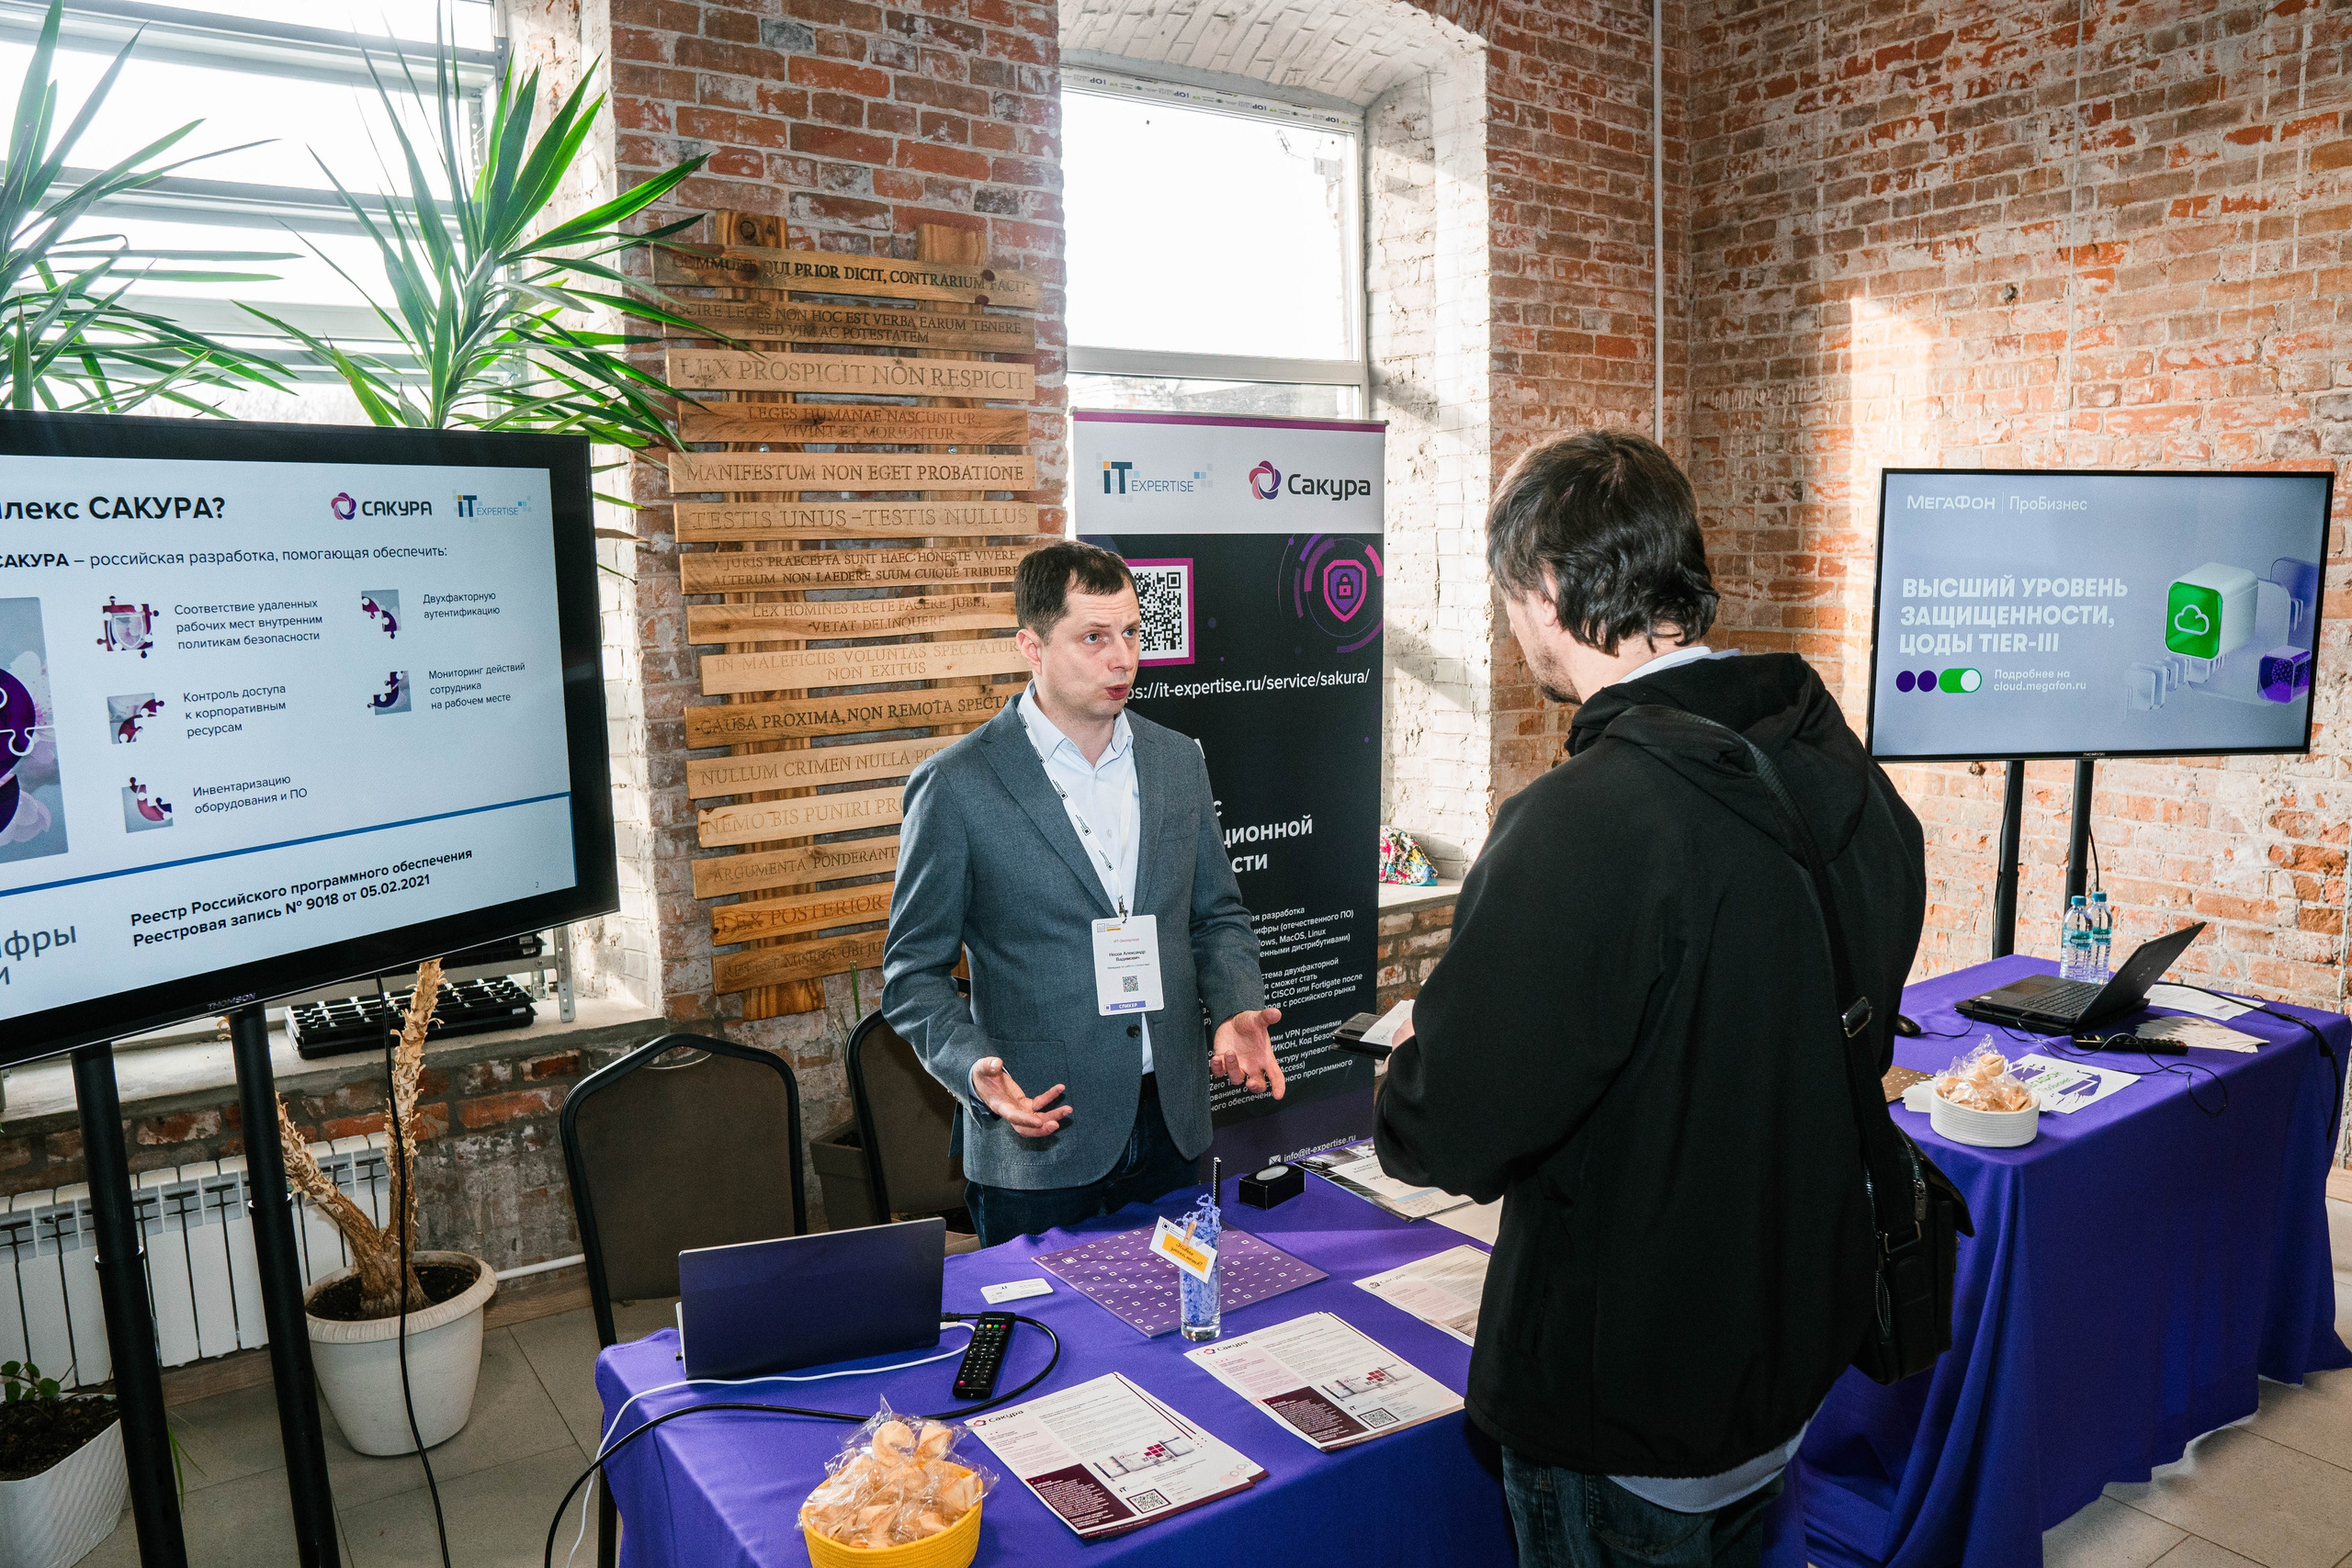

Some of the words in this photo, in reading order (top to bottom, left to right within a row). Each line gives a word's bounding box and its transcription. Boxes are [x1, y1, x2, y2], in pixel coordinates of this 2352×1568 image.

[794, 263, 841, 279] PRIOR
[843, 266, 888, 284] DICIT,
[889, 270, 985, 289] CONTRARIUM
[726, 305, 772, 319] LEGES
[775, 308, 807, 321] NON
[812, 310, 842, 322] HOC
[846, 311, 870, 325] EST
[874, 313, 916, 328] VERBA
[920, 316, 966, 331] EARUM
[972, 320, 1023, 334] TENERE
[757, 323, 784, 335] SED
[820, 326, 839, 339] AC
[843, 327, 930, 344] POTESTATEM
[680, 357, 731, 379] LEX
[738, 360, 865, 384] PROSPICIT
[873, 366, 924, 386] NON
[931, 367, 1027, 389] RESPICIT
[747, 406, 797, 421] LEGES
[804, 408, 882, 423] HUMANAE
[887, 410, 981, 426] NASCUNTUR,
[839, 425, 859, 438] ET
[863, 426, 956, 440] MORIUNTUR
[687, 464, 816, 481] MANIFESTUM
[822, 465, 863, 480] NON
[867, 465, 912, 480] EGET
[916, 465, 1024, 480] PROBATIONE
[1131, 479, 1194, 492] EXPERTISE
[1287, 474, 1372, 502] Сакура
[89, 496, 226, 519] САКУРА?
[362, 501, 433, 516] САКУРА
[477, 506, 518, 516] EXPERTISE
[2009, 495, 2087, 514] ПроБизнес
[692, 511, 773, 530] TESTIS
[780, 510, 847, 528] UNUS
[944, 508, 1028, 525] NULLUS
[90, 551, 185, 569] российская
[189, 548, 278, 566] разработка,
[282, 548, 369, 561] помогающая
[373, 546, 447, 558] обеспечить:
[724, 557, 763, 570] JURIS
[768, 554, 841, 568] PRAECEPTA
[844, 553, 877, 565] SUNT
[919, 551, 971, 563] HONESTE
[976, 550, 1020, 561] VIVERE,
[712, 573, 775, 586] ALTERUM
[783, 572, 811, 584] NON
[876, 570, 910, 581] SUUM
[914, 568, 960, 581] CUIQUE
[1902, 574, 2016, 598] ВЫСШИЙ
[2021, 577, 2129, 598] УРОВЕНЬ
[175, 603, 255, 615] Соответствие
[258, 600, 318, 613] удаленных
[423, 592, 496, 605] Двухфакторную
[752, 605, 780, 618] LEX
[784, 604, 848, 616] HOMINES
[852, 602, 897, 614] RECTE
[899, 599, 946, 611] FACERE
[951, 596, 990, 611] JUBET,
[424, 607, 501, 620] аутентификацию
[1900, 604, 2115, 628] ЗАЩИЩЕННОСТИ,
[176, 621, 226, 635] рабочих
[229, 620, 255, 629] мест
[258, 615, 323, 629] внутренним
[811, 620, 856, 633] VETAT
[862, 615, 945, 631] DELINQUERE
[178, 637, 241, 649] политикам
[243, 632, 320, 645] безопасности
[1899, 633, 1973, 656] ЦОДЫ
[1978, 632, 2060, 653] TIER-III
[715, 659, 734, 671] IN
[844, 646, 926, 663] VOLUNTAS
[428, 667, 484, 680] Мониторинг
[485, 662, 526, 675] действий
[828, 666, 863, 681] NON
[870, 662, 926, 678] EXITUS
[1994, 669, 2054, 681] Подробнее
[2057, 670, 2070, 679] на
[184, 690, 240, 703] Контроль
[243, 685, 286, 698] доступа
[430, 682, 481, 695] сотрудника
[1993, 681, 2086, 693] cloud.megafon.ru
[186, 712, 192, 720] к
[196, 702, 287, 719] корпоративным
[431, 701, 442, 709] на
[445, 697, 483, 710] рабочем
[486, 694, 511, 703] месте
[700, 716, 758, 734] CAUSA
[762, 709, 846, 729] PROXIMA,
[847, 705, 883, 722] NON
[888, 699, 954, 718] REMOTA
[187, 723, 243, 739] ресурсам
[700, 763, 778, 786] NULLUM
[784, 756, 852, 776] CRIMEN
[855, 750, 910, 770] NULLA
[193, 775, 291, 797] Инвентаризацию
[195, 794, 278, 814] оборудования
[280, 793, 288, 801] и
[290, 788, 308, 799] ПО
[705, 813, 765, 835] NEMO
[772, 809, 799, 827] BIS
[804, 800, 870, 823] PUNIRI
[713, 859, 807, 882] ARGUMENTA
[131, 907, 187, 927] Реестр
[191, 887, 287, 914] Российского
[290, 866, 389, 895] программного
[392, 849, 472, 873] обеспечения
[133, 919, 227, 946] Реестровая
[231, 908, 282, 926] запись
[306, 893, 339, 910] 9018
[343, 891, 356, 903] от
[360, 874, 430, 899] 05.02.2021
[770, 894, 886, 926] POSTERIOR
[1261, 908, 1305, 921] разработка
[1281, 913, 1340, 931] (отечественного
[1340, 909, 1354, 919] ПО)
[0, 925, 76, 961] фры
[1279, 931, 1306, 943] MacOS,
[1307, 929, 1326, 938] Linux
[1291, 933, 1351, 953] дистрибутивами)
[1284, 957, 1340, 976] двухфакторной
[1271, 977, 1297, 989] сможет
[1299, 974, 1317, 983] стать
[1272, 987, 1295, 999] CISCO
[1296, 986, 1310, 994] или
[1311, 977, 1341, 990] Fortigate
[1341, 974, 1363, 984] после
[1288, 990, 1332, 1008] российского
[1333, 985, 1356, 997] рынка
[1284, 1029, 1301, 1039] VPN
[1301, 1020, 1341, 1036] решениями
[1299, 1036, 1312, 1045] Код
[1303, 1059, 1353, 1078] программного
[1209, 1081, 1226, 1091] Zero
[1283, 1134, 1357, 1162] info@it-expertise.ru
[989, 1410, 1023, 1423] Сакура
